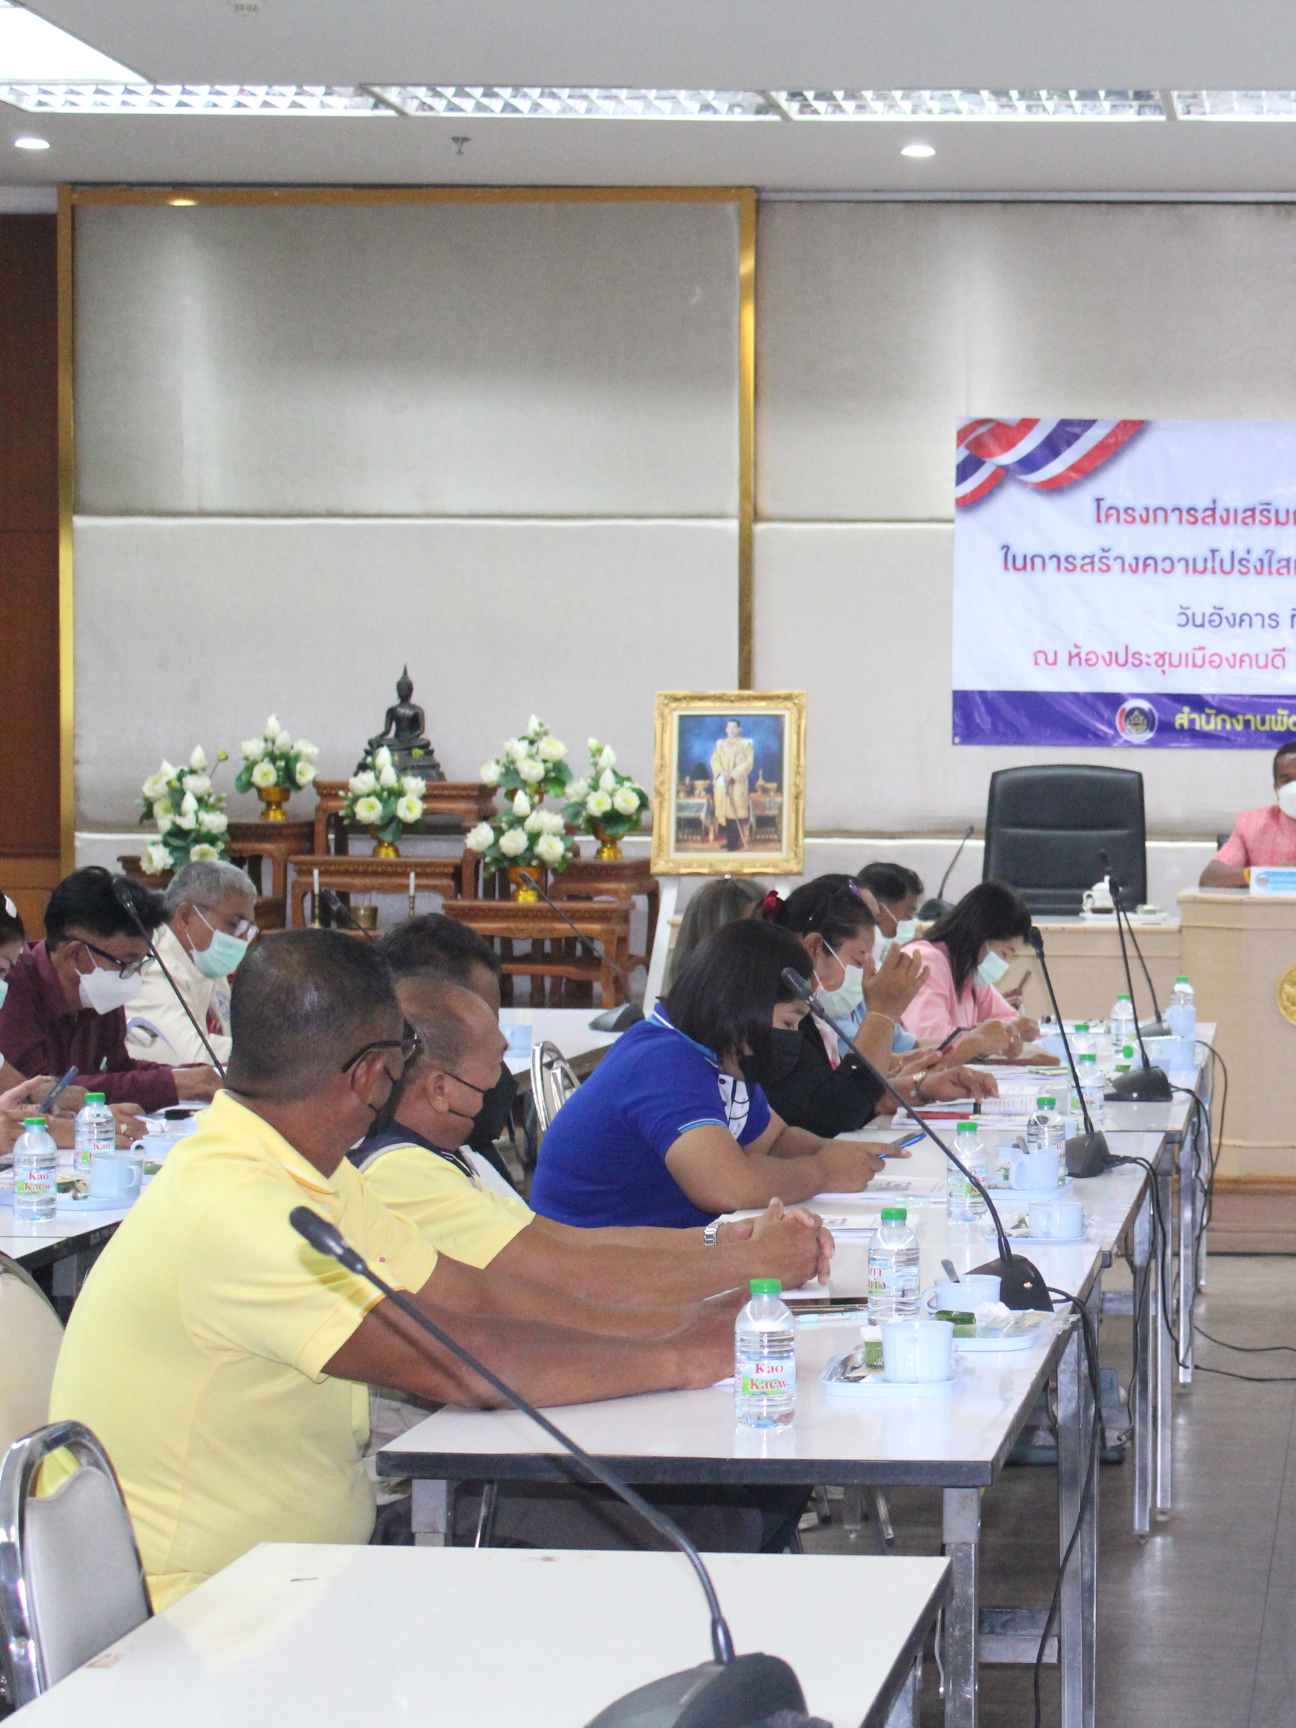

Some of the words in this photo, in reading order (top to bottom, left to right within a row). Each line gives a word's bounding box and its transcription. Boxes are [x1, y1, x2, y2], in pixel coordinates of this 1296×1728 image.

[1177, 605, 1279, 629] วันอังคาร
[1033, 648, 1058, 667] ณ
[1068, 644, 1287, 676] ห้องประชุมเมืองคนดี
[29, 1171, 50, 1180] Kao
[755, 1363, 784, 1374] Kao
[749, 1378, 788, 1390] Kaew
